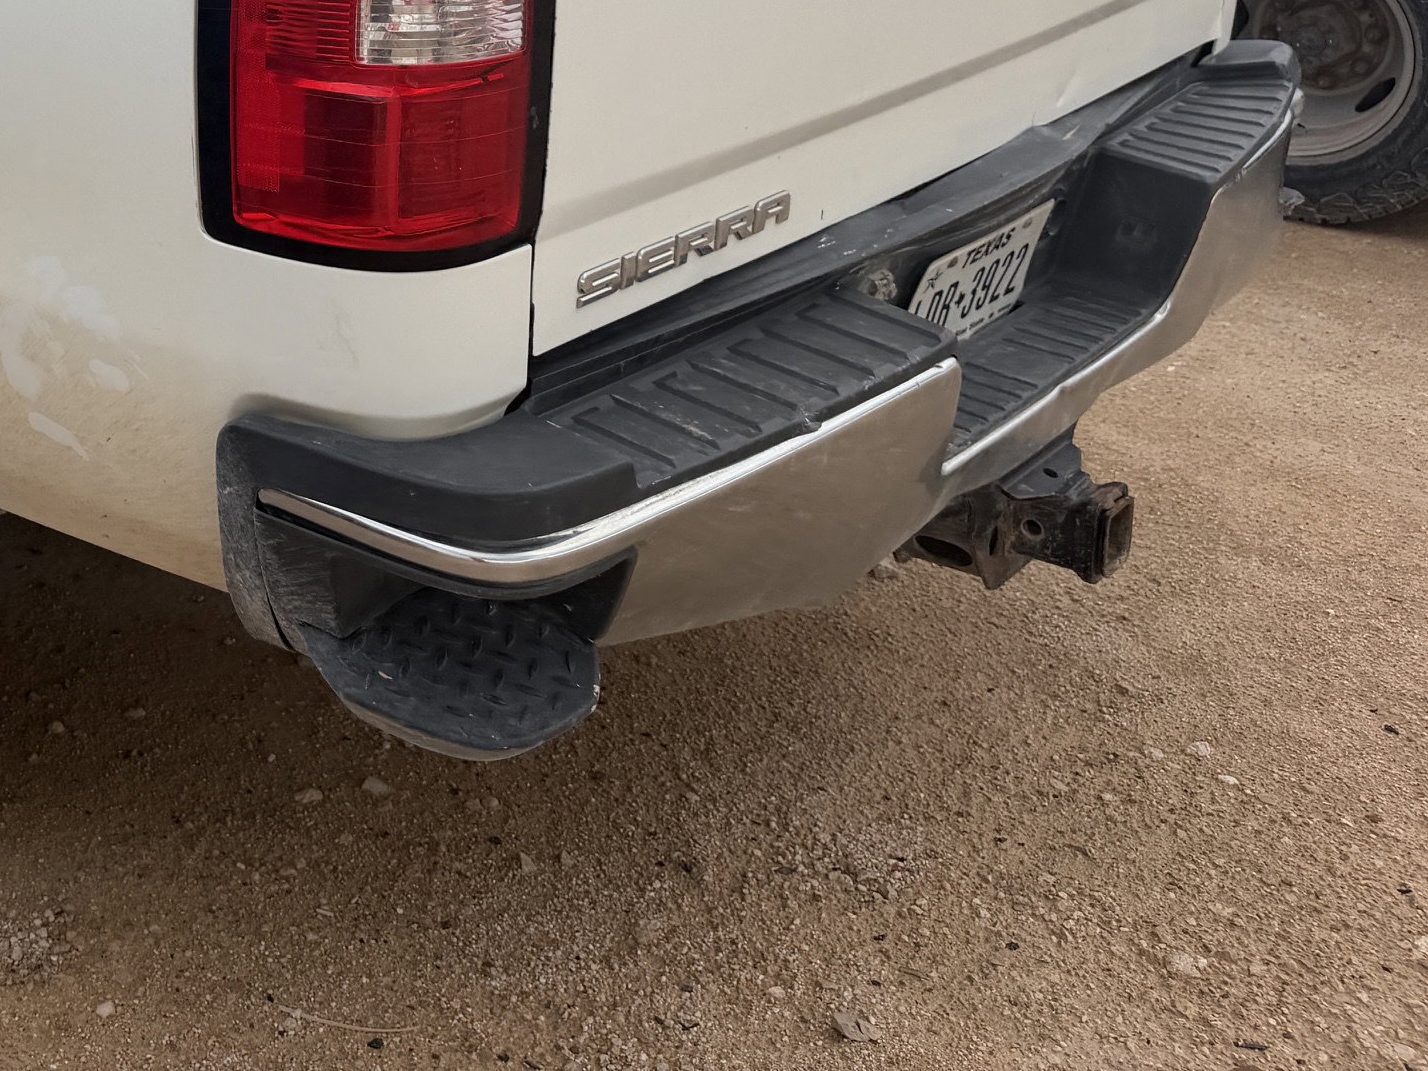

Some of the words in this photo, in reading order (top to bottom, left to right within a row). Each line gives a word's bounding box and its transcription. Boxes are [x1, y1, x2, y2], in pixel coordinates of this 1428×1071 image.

[576, 190, 790, 309] SIERRA
[960, 242, 1029, 319] 3922
[962, 227, 1016, 269] TEXAS
